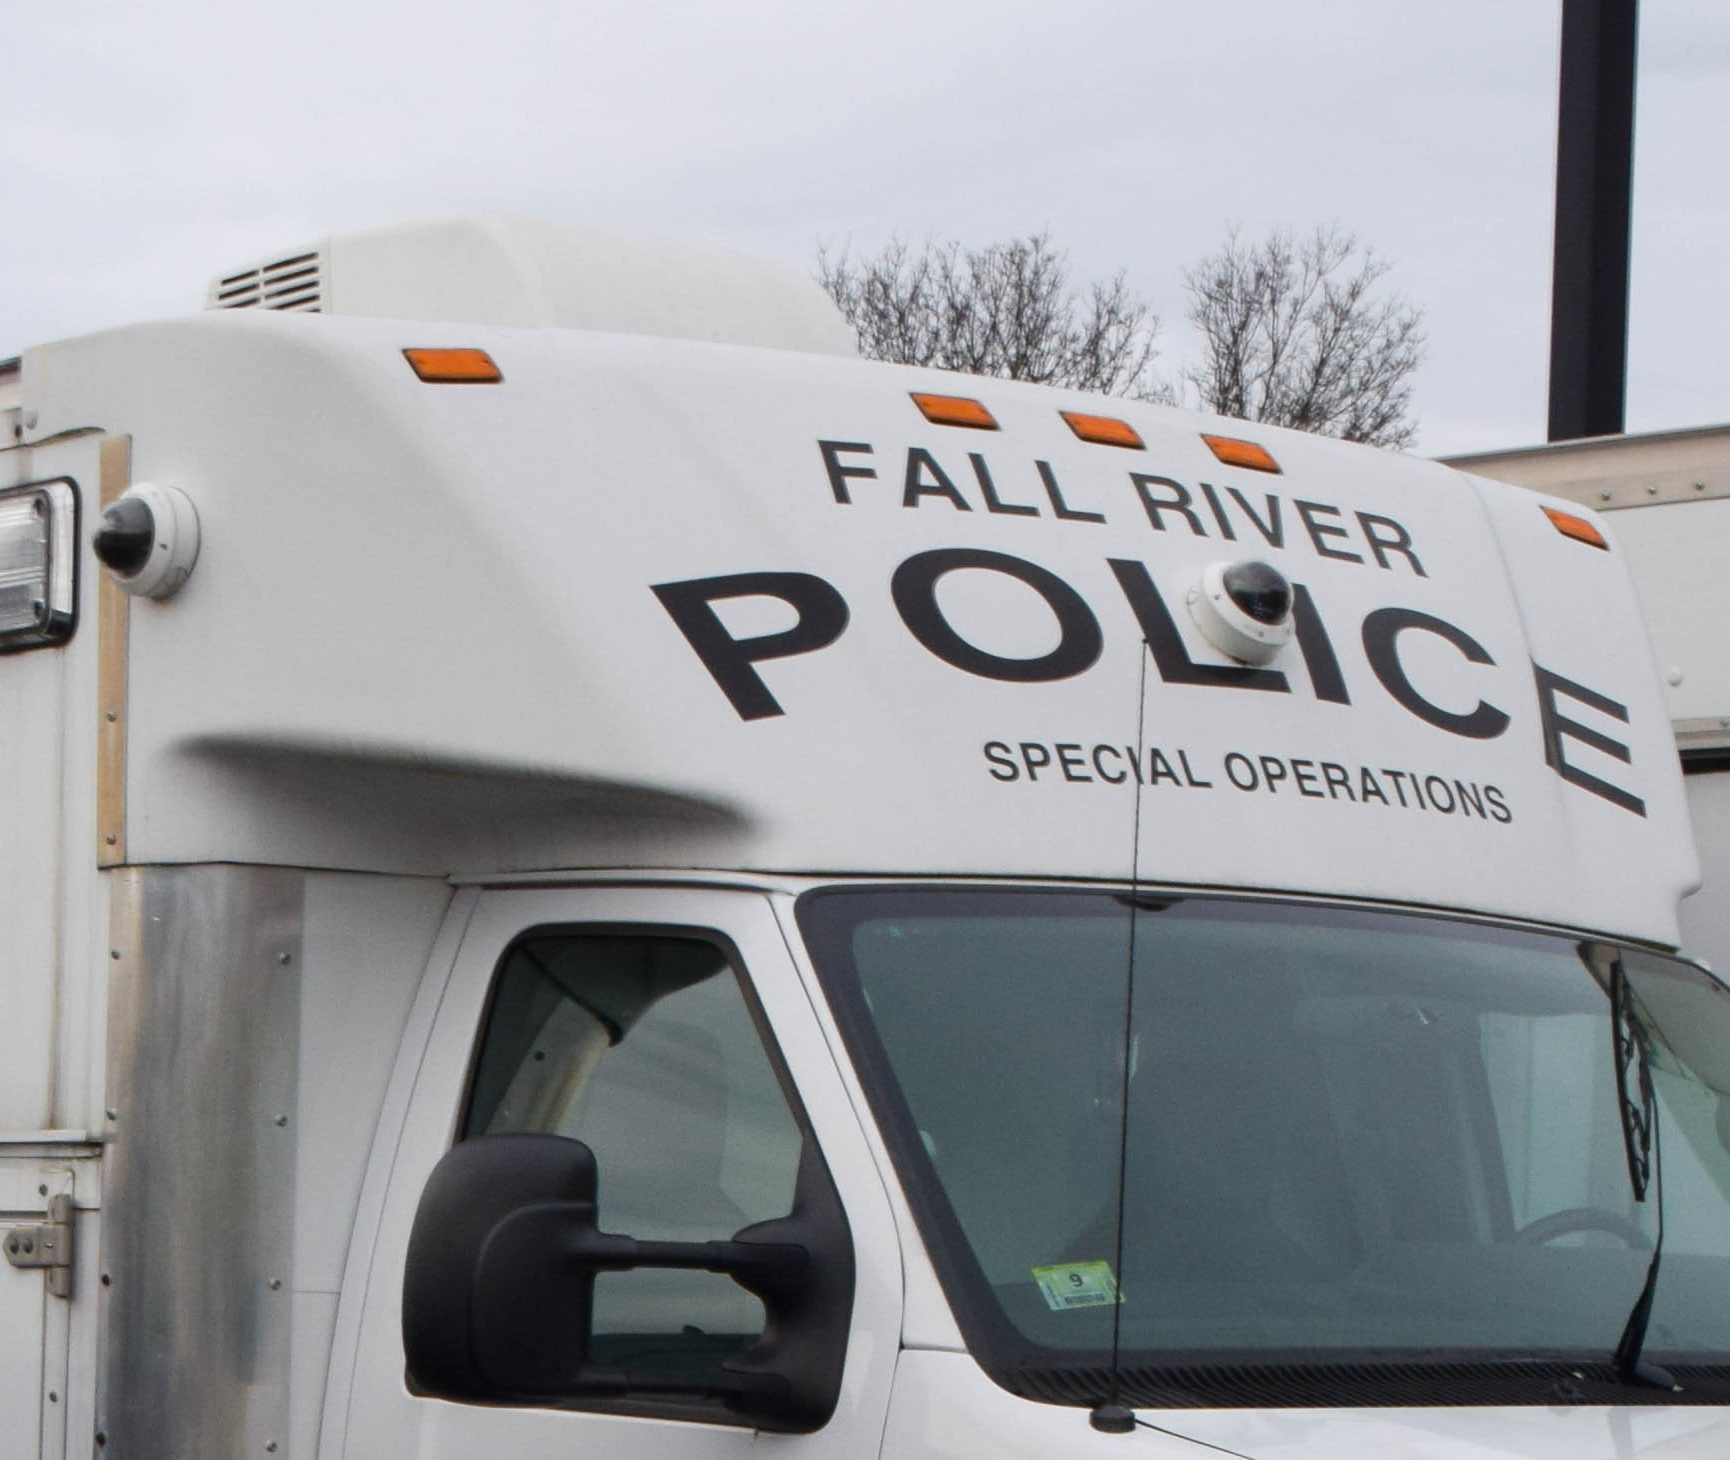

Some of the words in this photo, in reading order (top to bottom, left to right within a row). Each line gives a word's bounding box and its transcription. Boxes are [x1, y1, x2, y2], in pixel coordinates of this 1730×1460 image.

[818, 440, 1106, 526] FALL
[1130, 472, 1430, 579] RIVER
[650, 547, 1647, 818] POLICE
[984, 741, 1212, 791] SPECIAL
[1226, 751, 1513, 825] OPERATIONS
